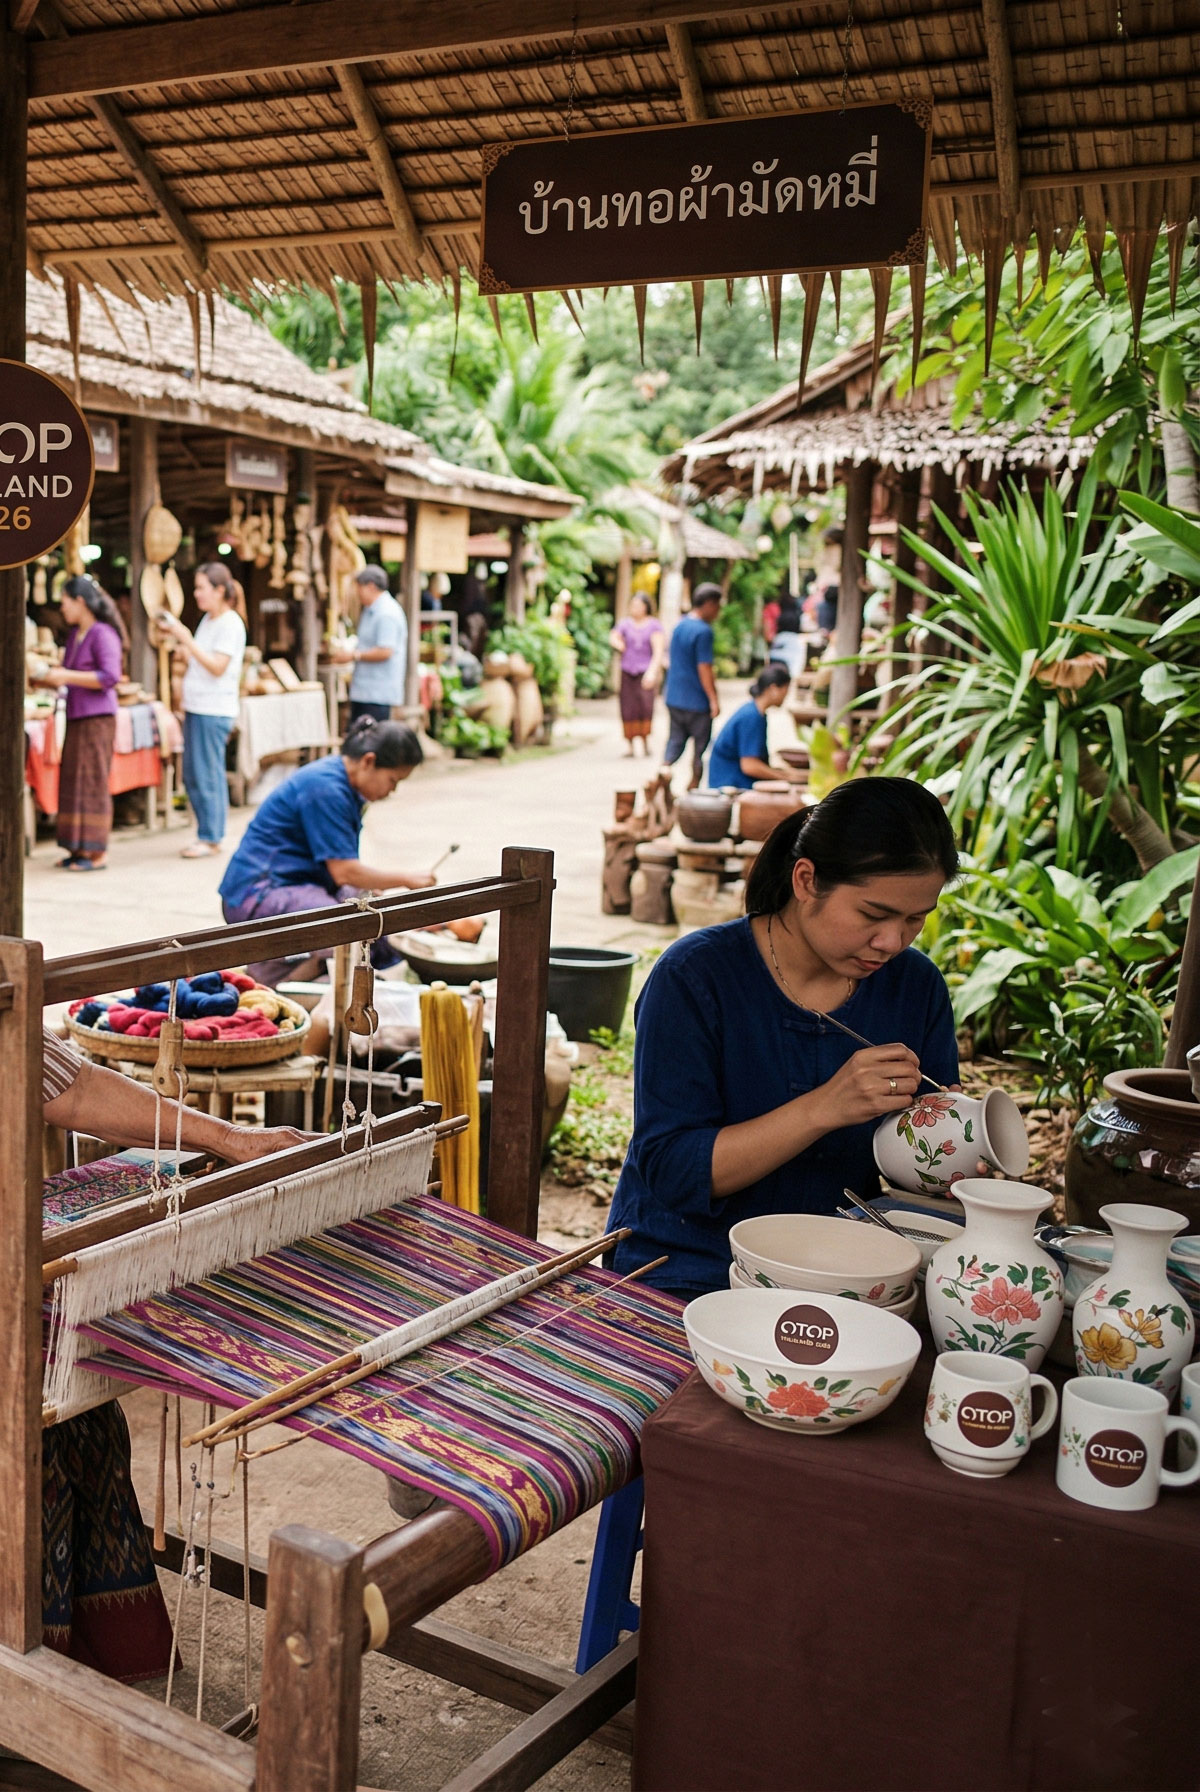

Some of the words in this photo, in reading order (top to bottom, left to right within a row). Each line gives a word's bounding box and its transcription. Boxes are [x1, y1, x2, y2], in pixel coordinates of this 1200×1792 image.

[518, 134, 879, 236] บ้านทอผ้ามัดหมี่
[780, 1320, 835, 1340] OTOP
[960, 1406, 1013, 1424] OTOP
[1089, 1443, 1145, 1464] OTOP
